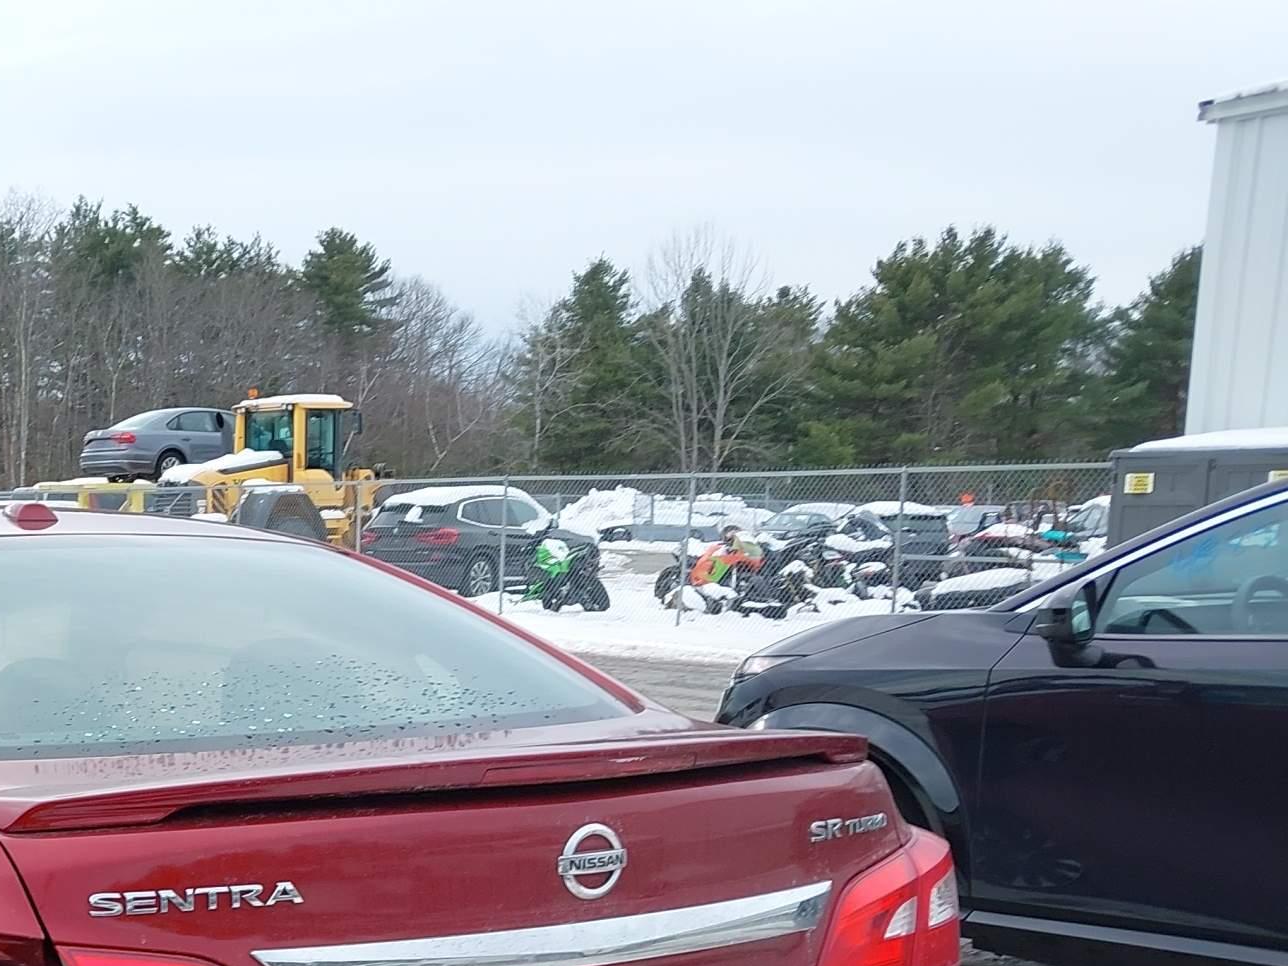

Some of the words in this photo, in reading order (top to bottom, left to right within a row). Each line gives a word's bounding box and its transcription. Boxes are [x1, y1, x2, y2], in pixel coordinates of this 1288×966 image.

[810, 818, 843, 842] SR
[569, 854, 623, 870] NISSAN
[88, 881, 304, 917] SENTRA
